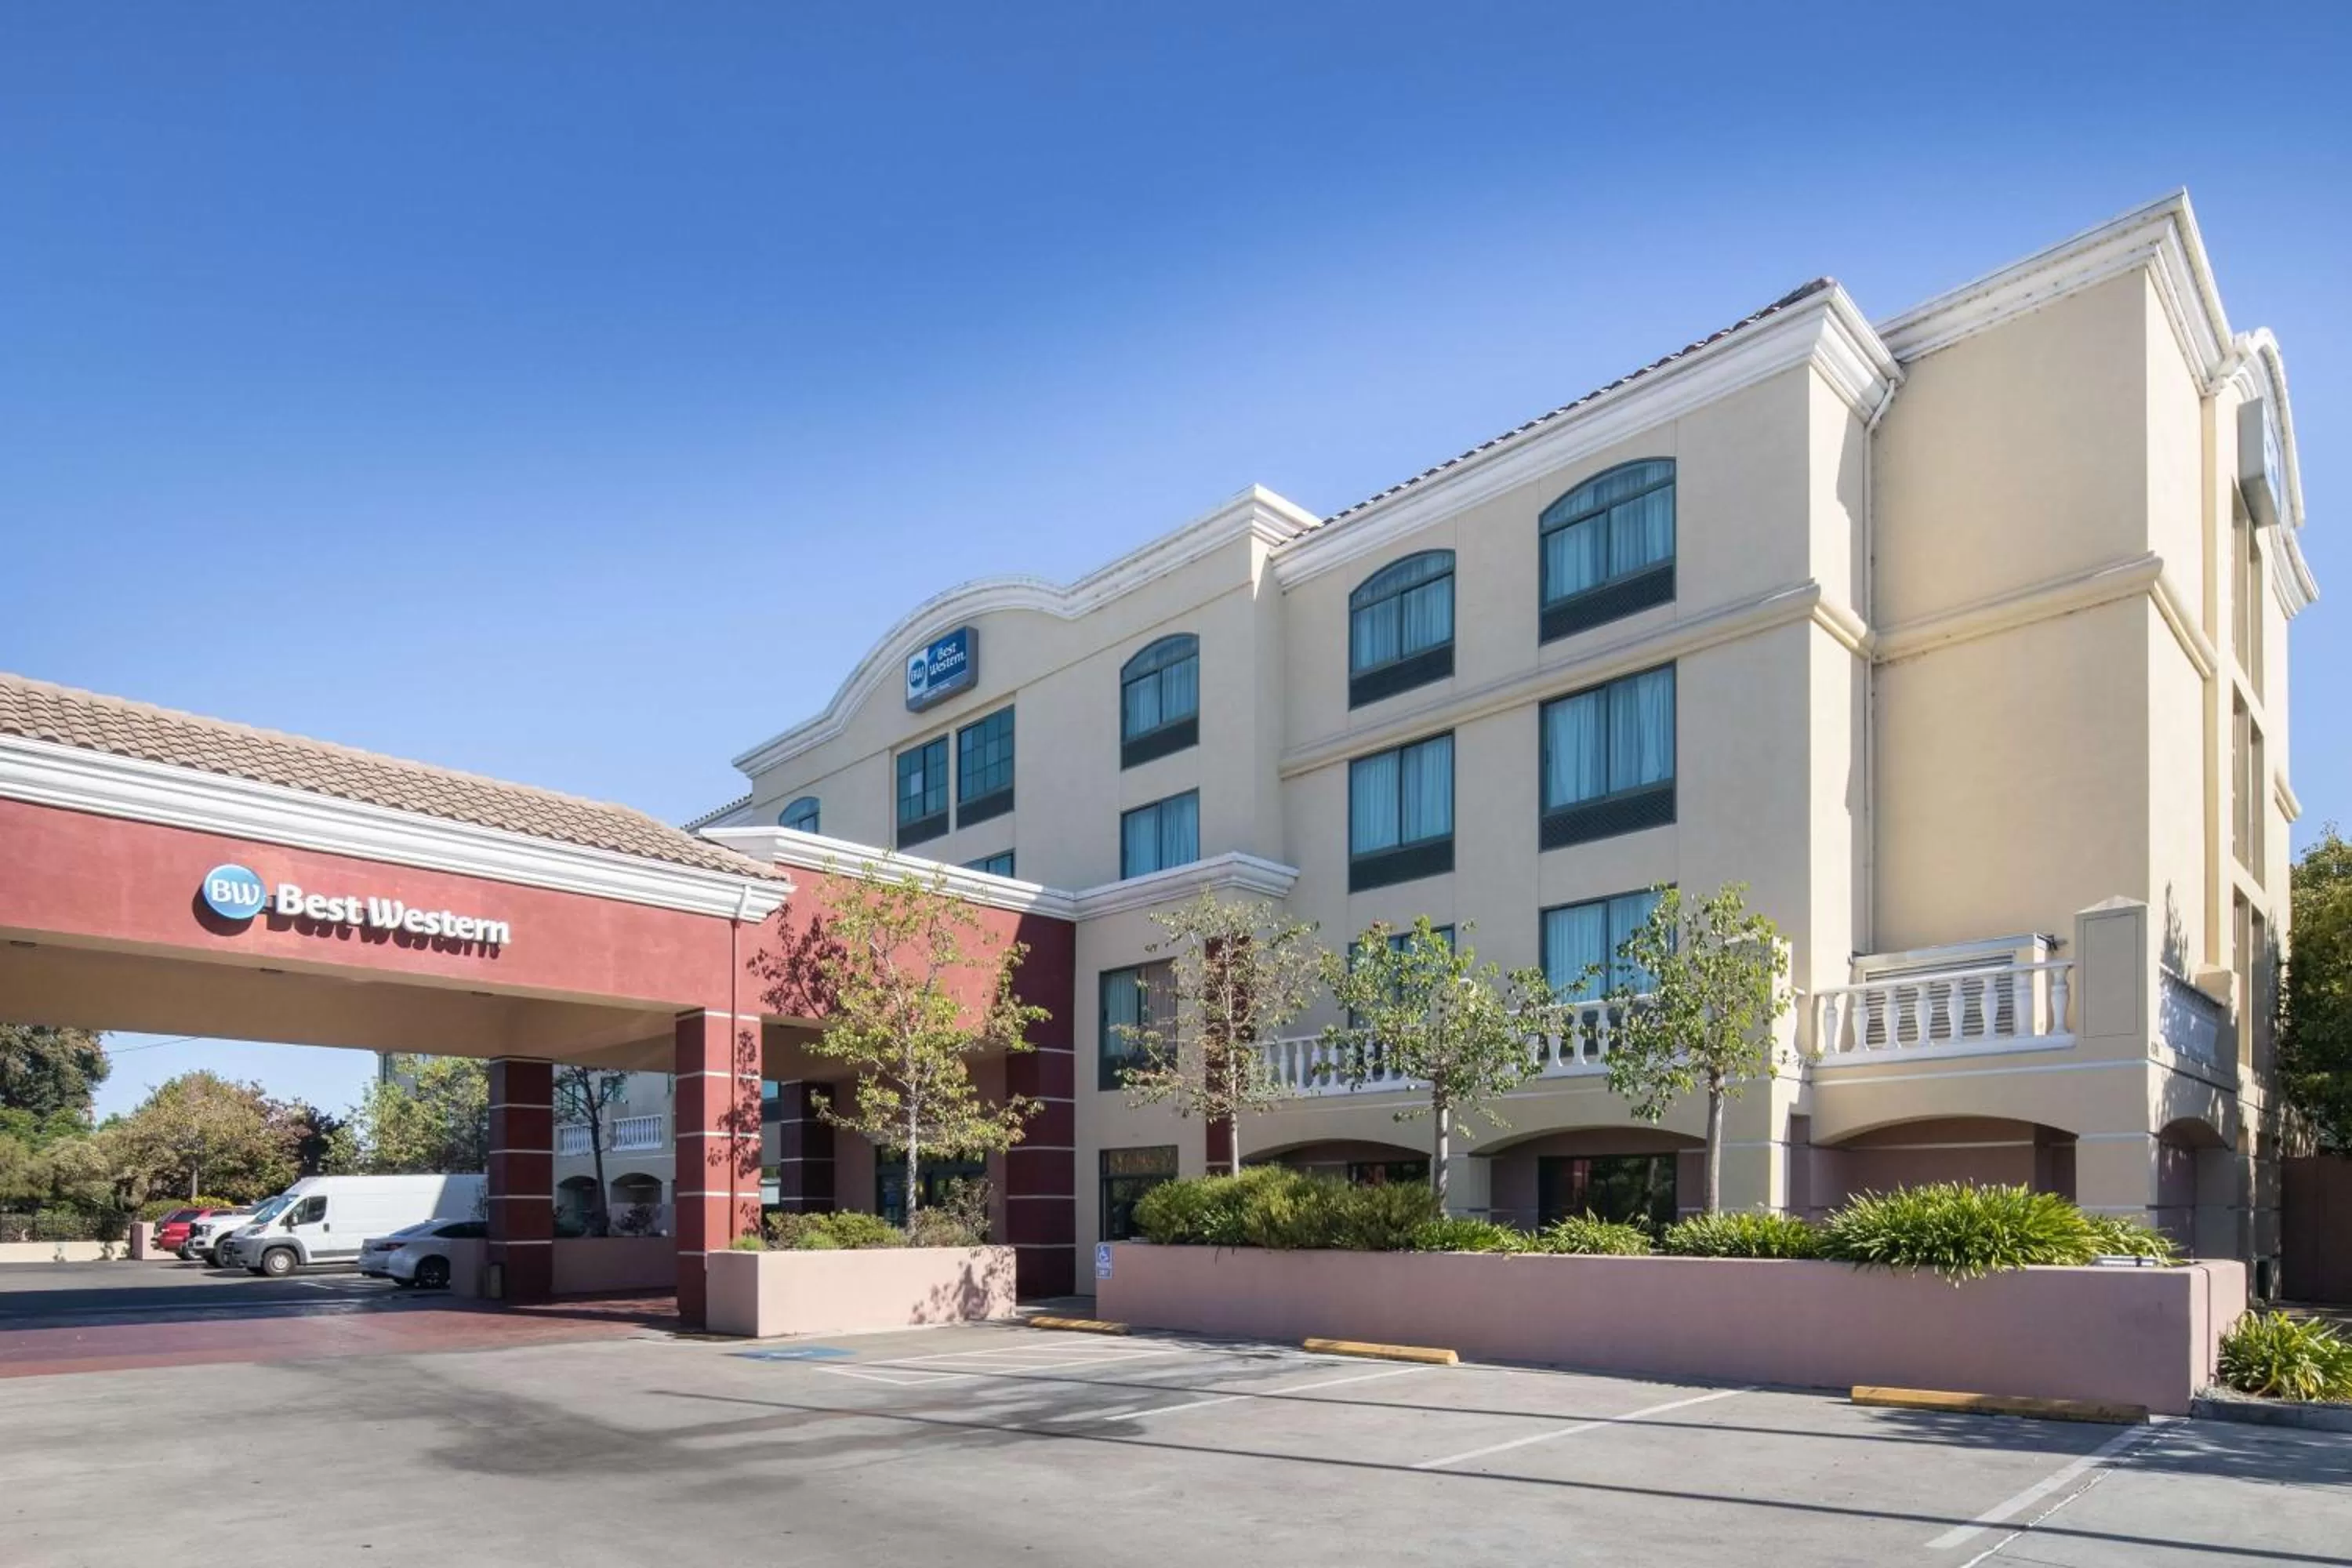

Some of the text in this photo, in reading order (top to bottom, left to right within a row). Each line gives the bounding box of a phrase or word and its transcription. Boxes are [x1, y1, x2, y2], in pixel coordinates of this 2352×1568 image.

[937, 642, 957, 660] Best
[210, 879, 261, 906] BW
[278, 884, 511, 944] Best Western
